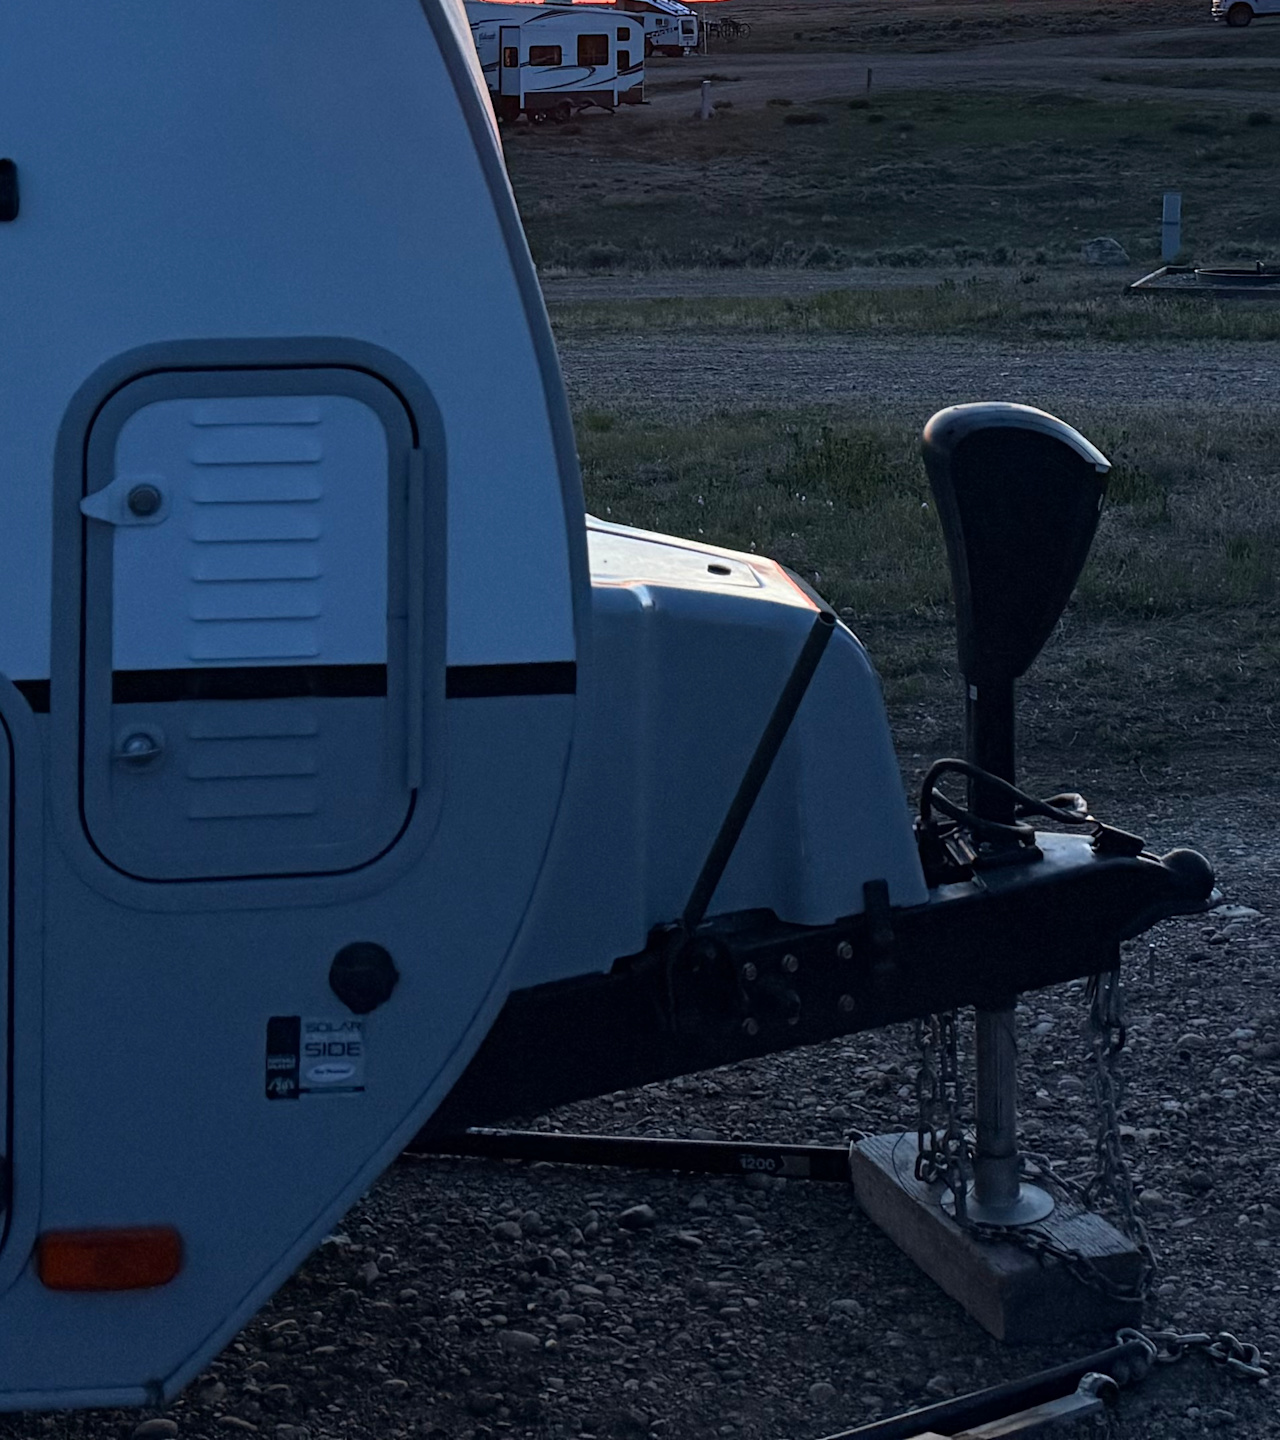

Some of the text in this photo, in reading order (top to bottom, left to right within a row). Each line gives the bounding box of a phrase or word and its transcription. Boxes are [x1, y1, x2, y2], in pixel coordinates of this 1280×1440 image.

[304, 1021, 362, 1033] SOLAR
[304, 1041, 362, 1057] SIDE
[739, 1157, 776, 1170] 1200
